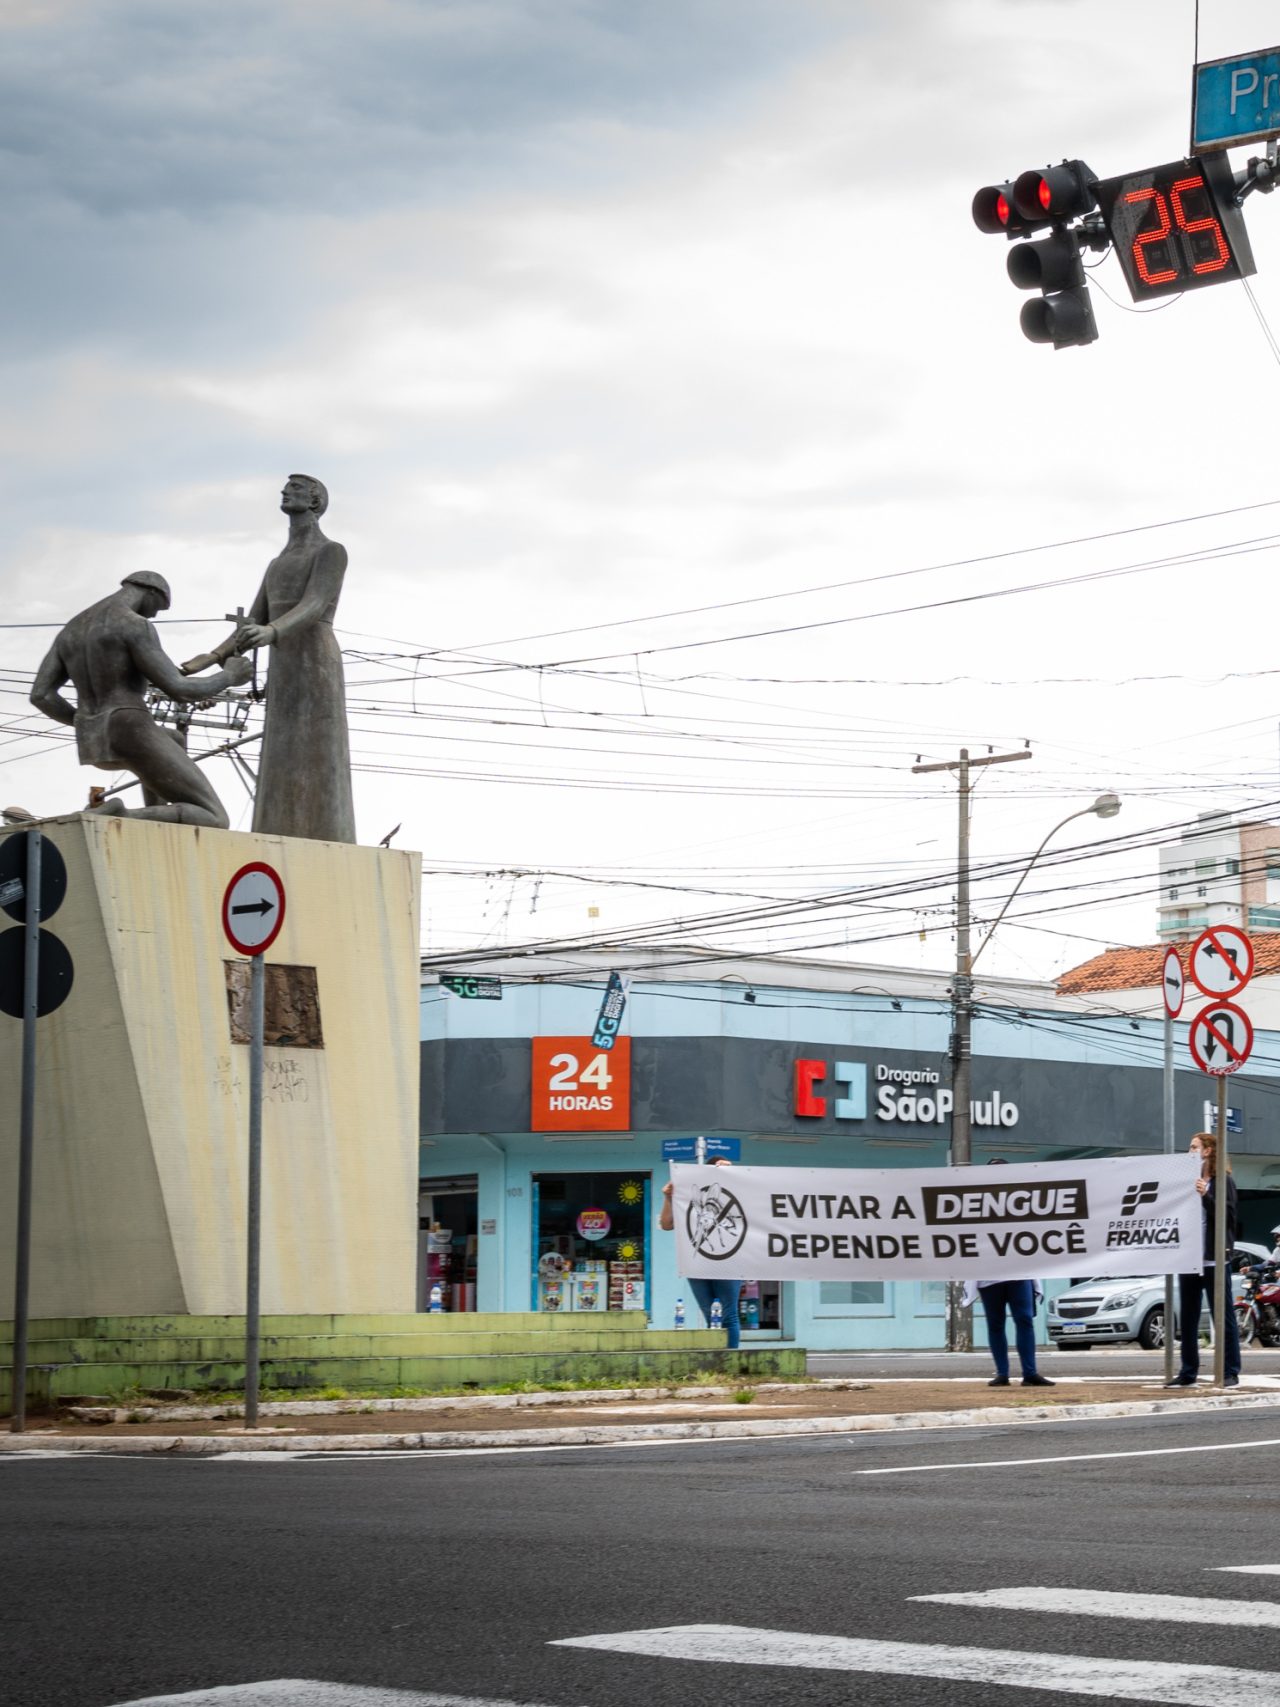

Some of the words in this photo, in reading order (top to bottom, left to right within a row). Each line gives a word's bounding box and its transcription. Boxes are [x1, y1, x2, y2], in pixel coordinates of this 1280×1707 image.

[1124, 176, 1230, 285] 25
[594, 1017, 618, 1050] 5G
[549, 1053, 613, 1091] 24
[877, 1064, 940, 1086] Drogaria
[549, 1095, 614, 1111] HORAS
[877, 1084, 1019, 1127] SãoPulo
[770, 1194, 881, 1220] EVITAR
[891, 1195, 917, 1220] A
[936, 1187, 1079, 1219] DENGUE
[768, 1233, 921, 1259] DEPENDE
[934, 1232, 980, 1258] DE
[988, 1222, 1088, 1257] VOCÊ
[1105, 1227, 1180, 1247] FRANCA
[1108, 1218, 1180, 1230] PREFEITURA
